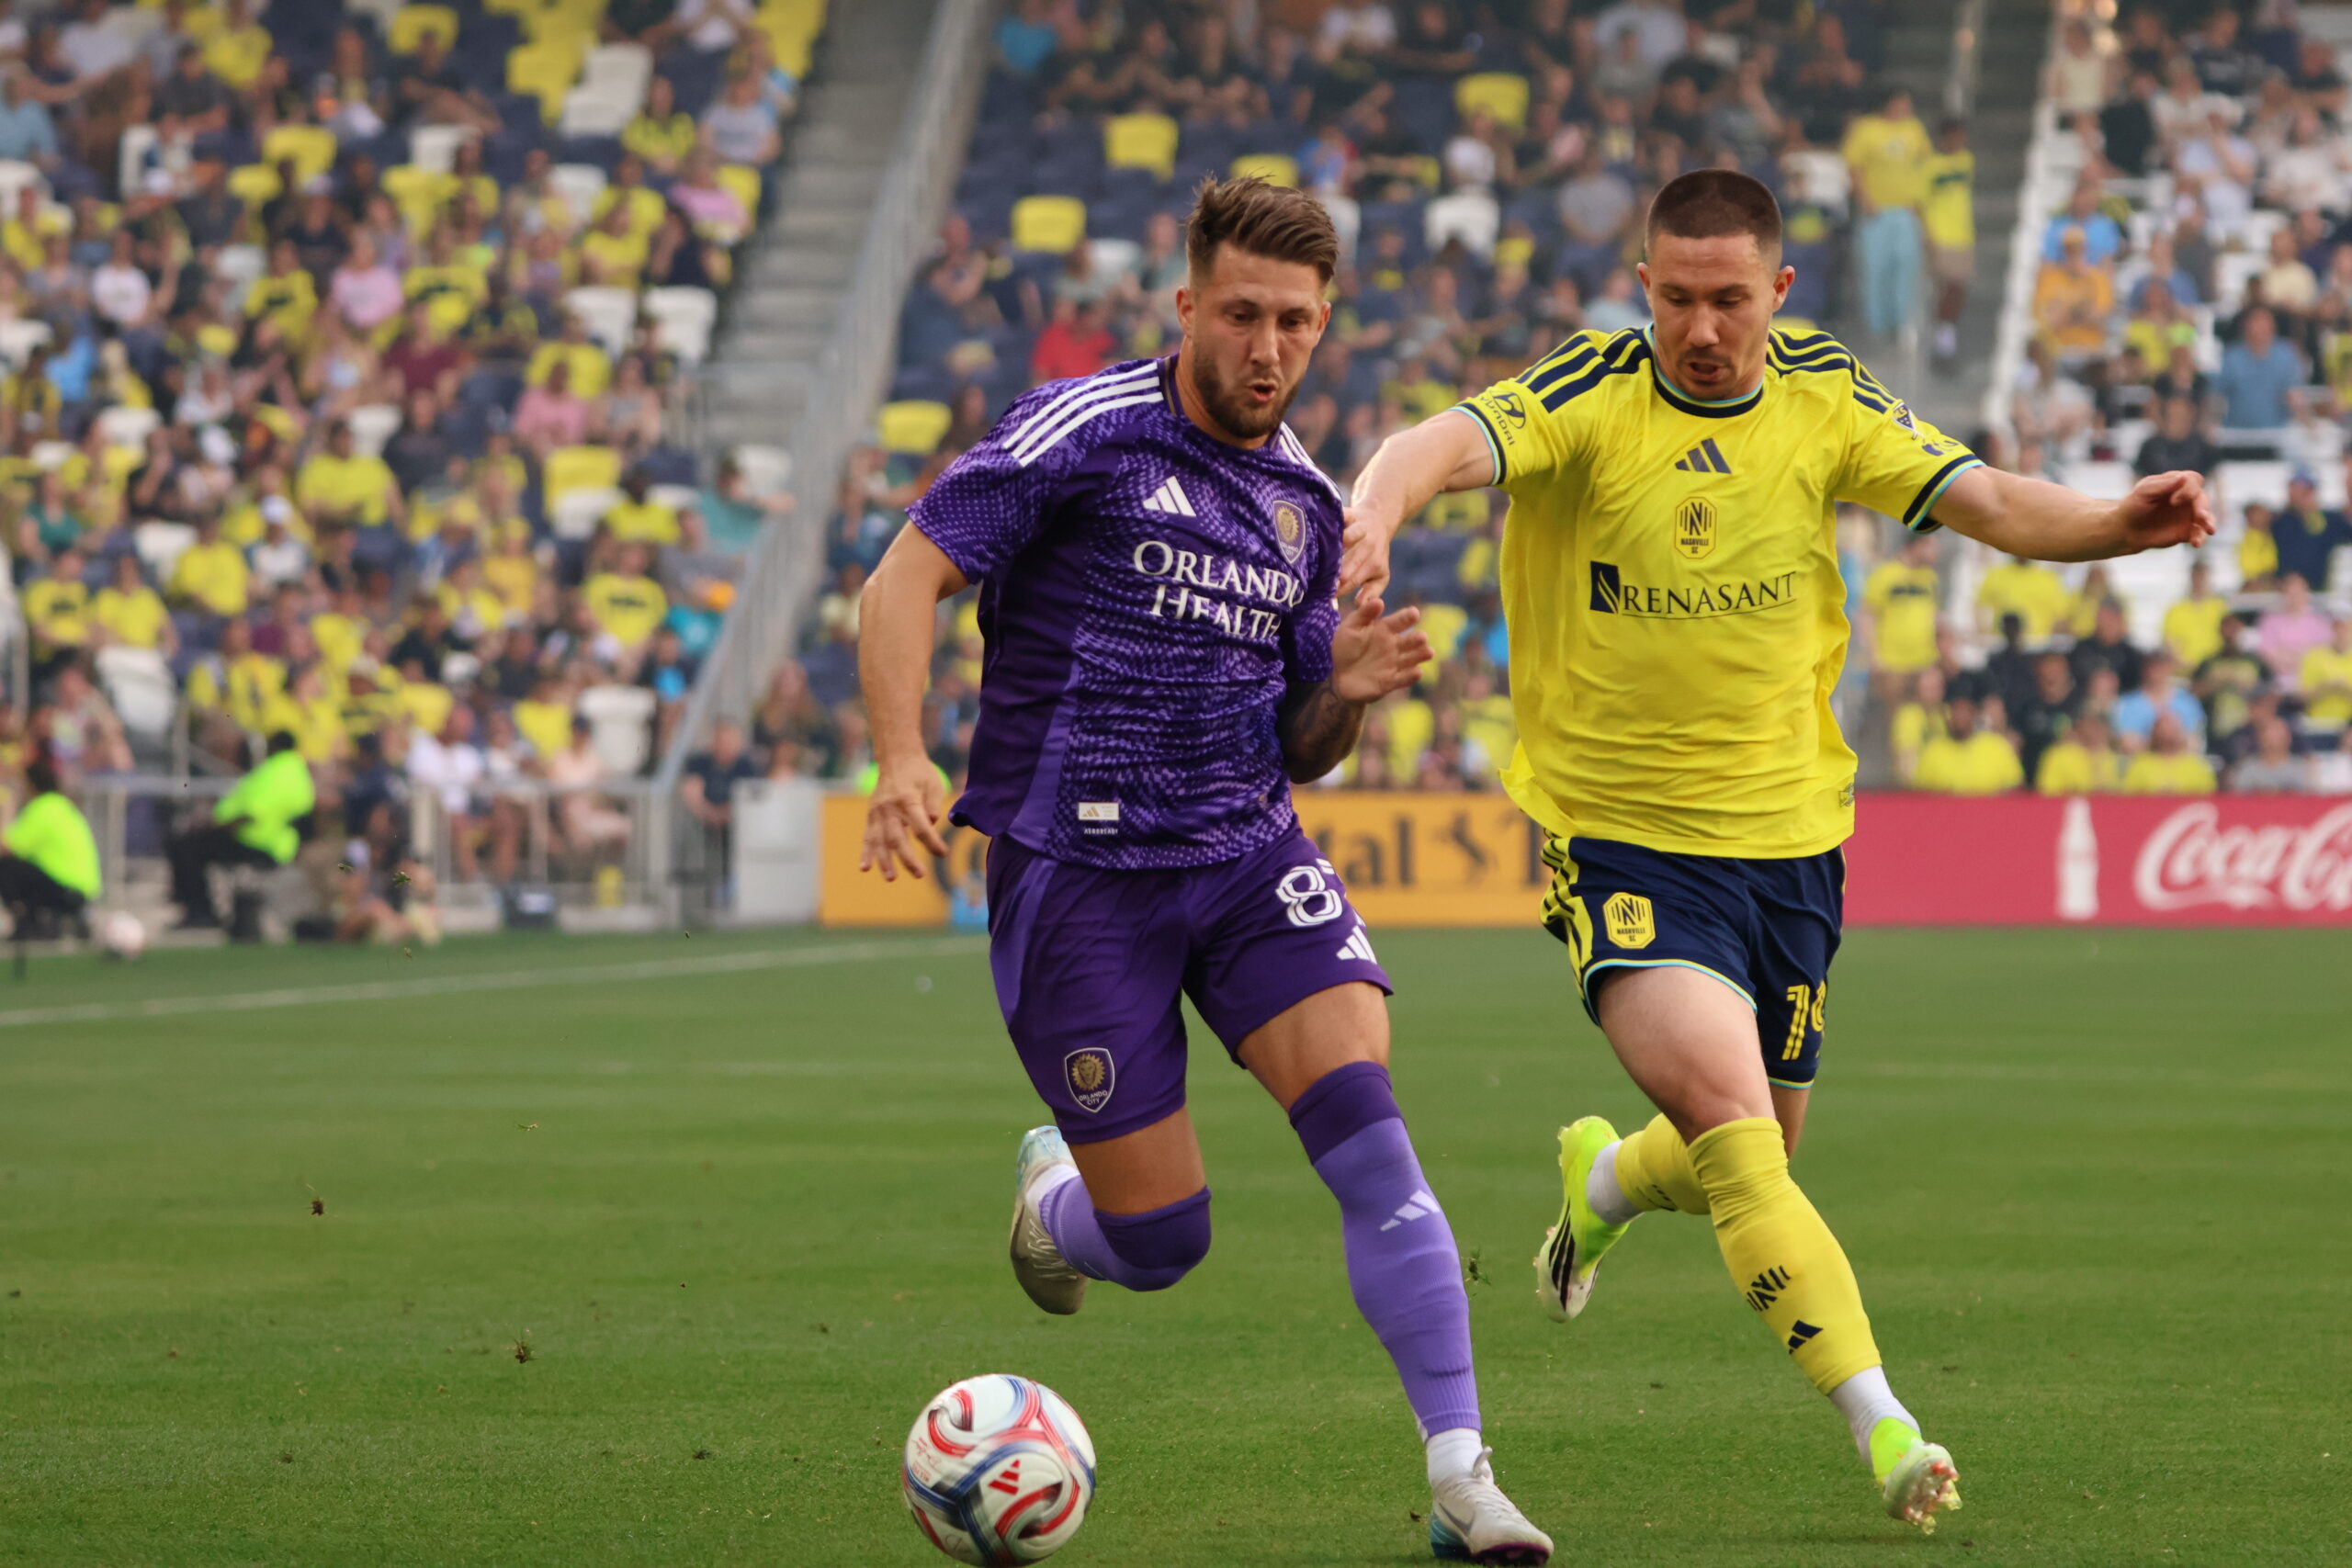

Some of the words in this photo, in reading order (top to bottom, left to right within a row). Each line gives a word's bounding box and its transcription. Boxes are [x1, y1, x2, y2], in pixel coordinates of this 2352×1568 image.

[1149, 584, 1283, 639] HEALTH
[1623, 570, 1796, 615] RENASANT
[1275, 858, 1342, 927] 8
[1079, 1090, 1108, 1101] ORLANDO
[1087, 1097, 1100, 1105] CITY
